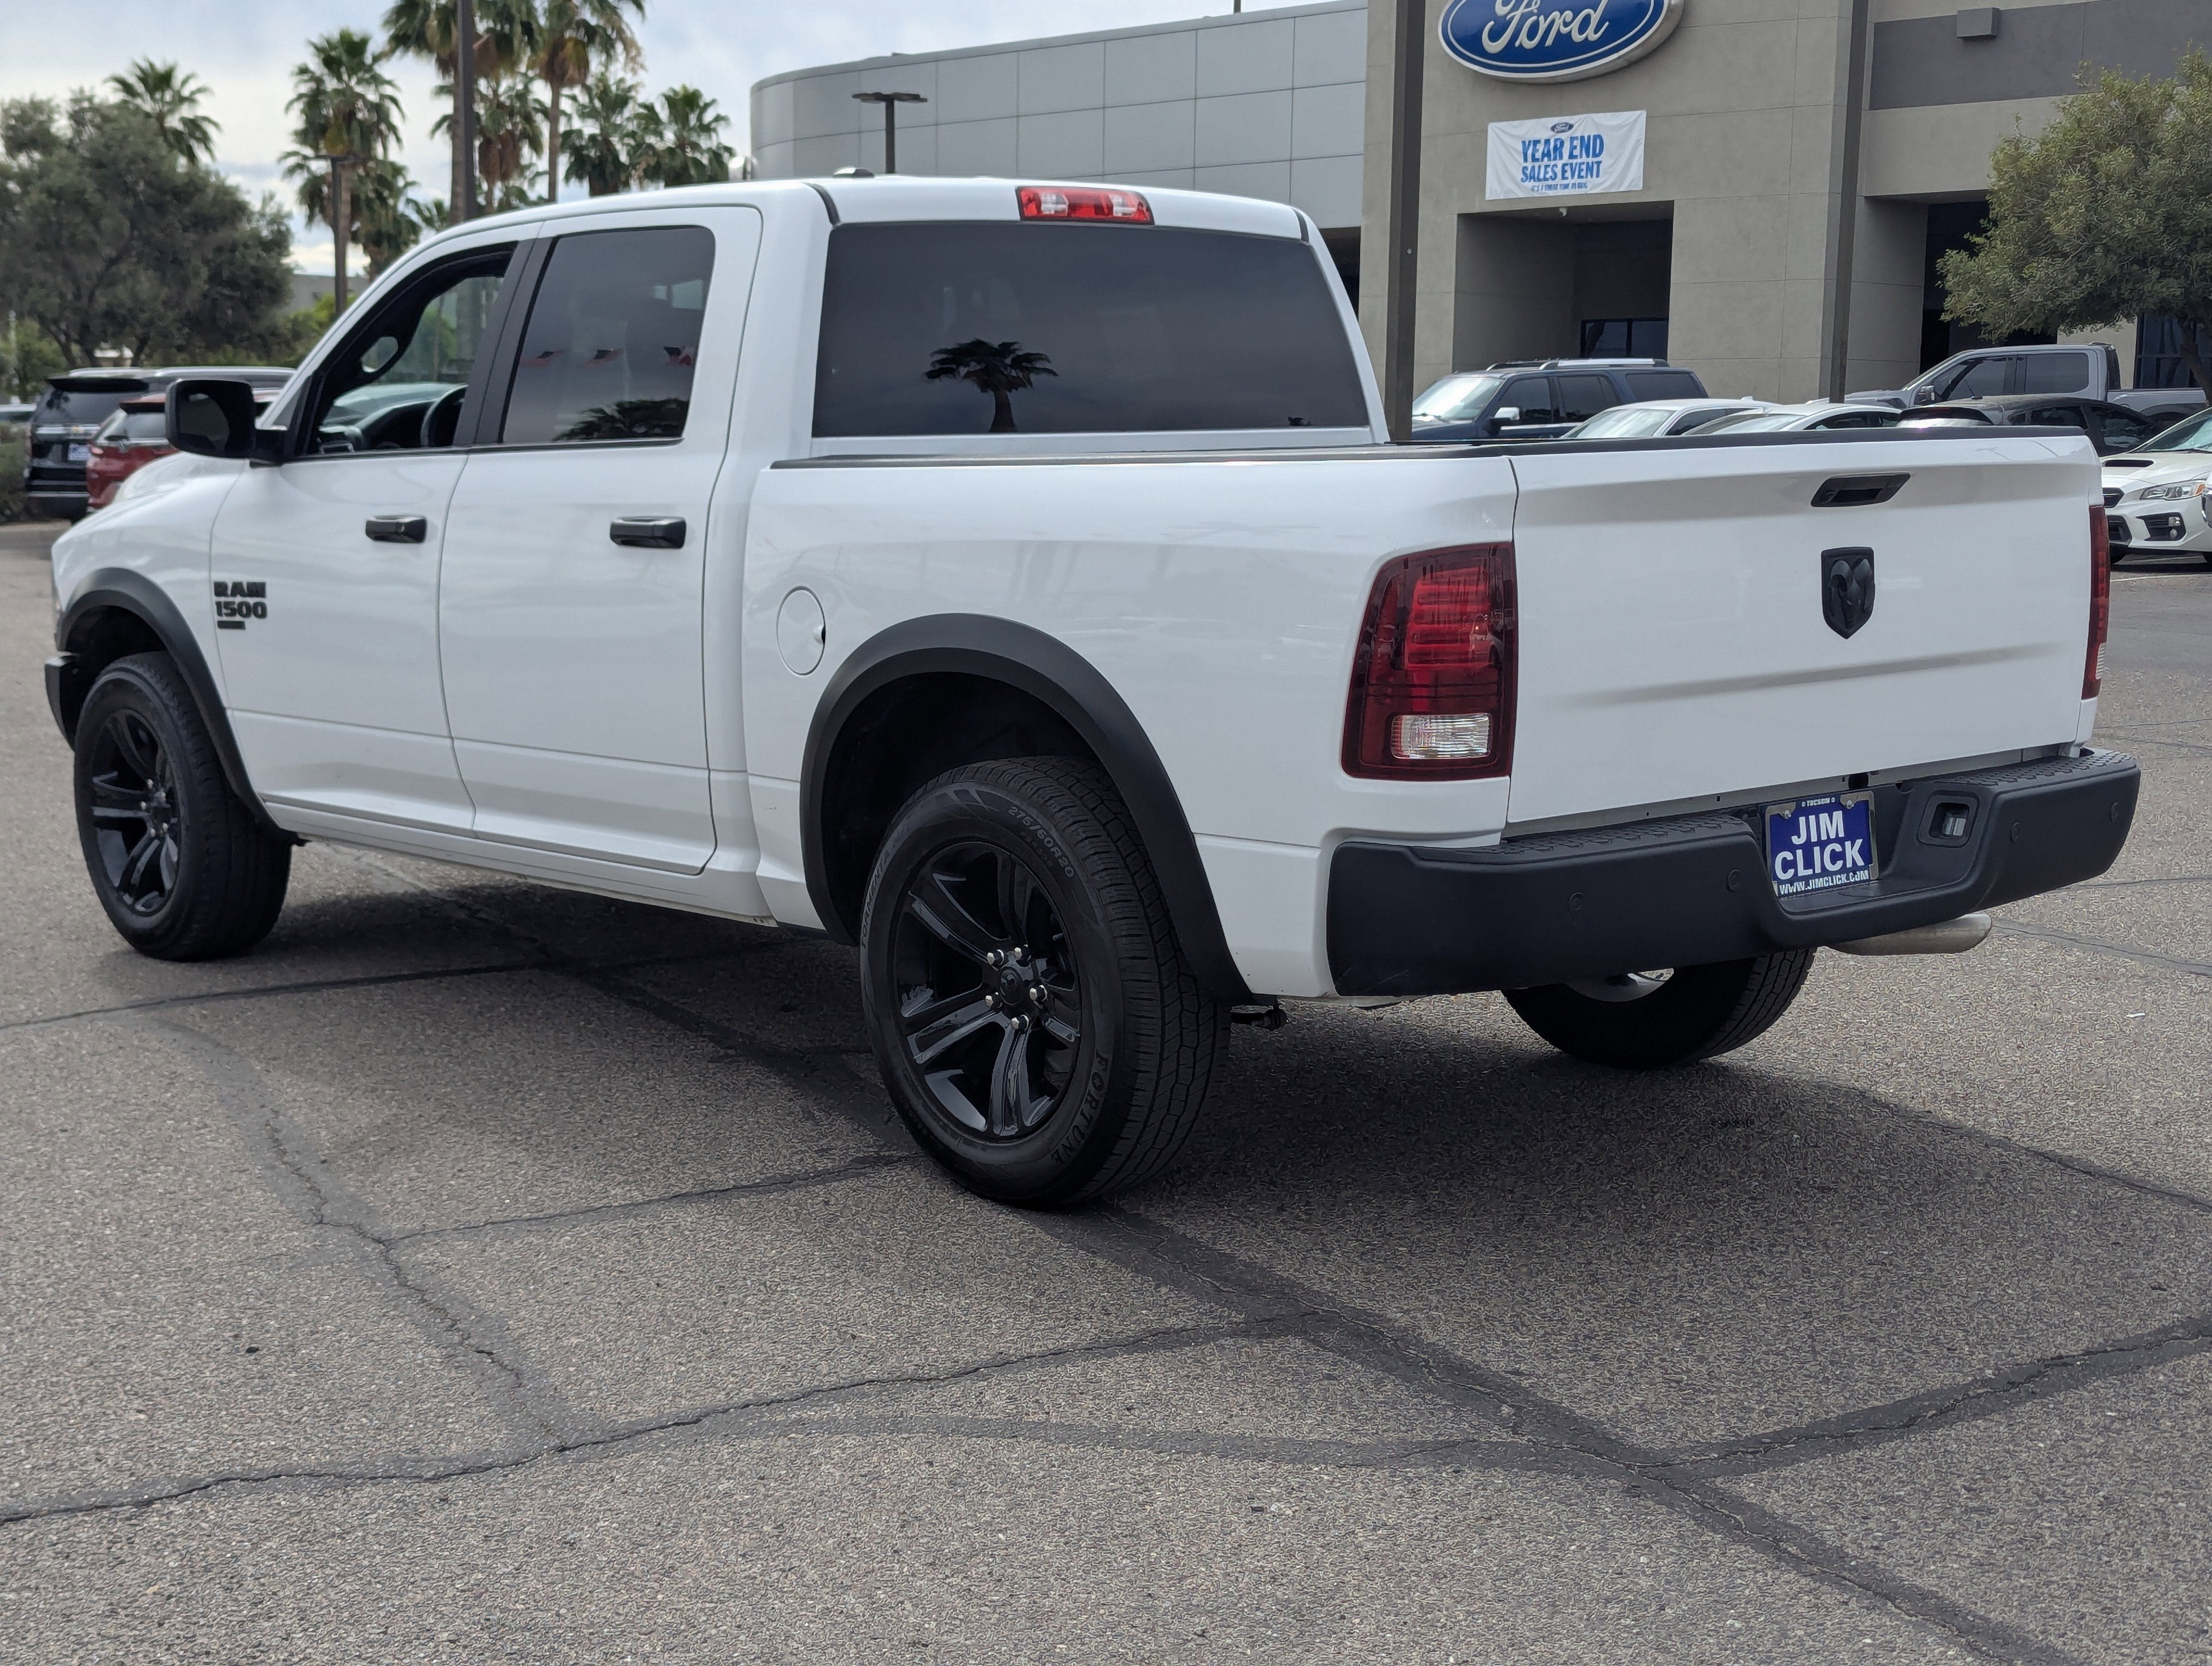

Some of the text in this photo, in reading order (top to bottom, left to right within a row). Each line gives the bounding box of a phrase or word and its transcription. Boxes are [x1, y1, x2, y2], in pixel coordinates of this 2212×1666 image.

[1482, 0, 1610, 54] Ford
[1521, 134, 1604, 163] YEAR END
[1521, 161, 1603, 183] SALES EVENT
[214, 581, 266, 599] RAM
[215, 600, 267, 619] 1500
[1007, 806, 1074, 877] 275/60R20
[1791, 810, 1844, 845] JIM
[1774, 838, 1865, 880] CLICK
[1050, 1049, 1109, 1165] FORTUNE
